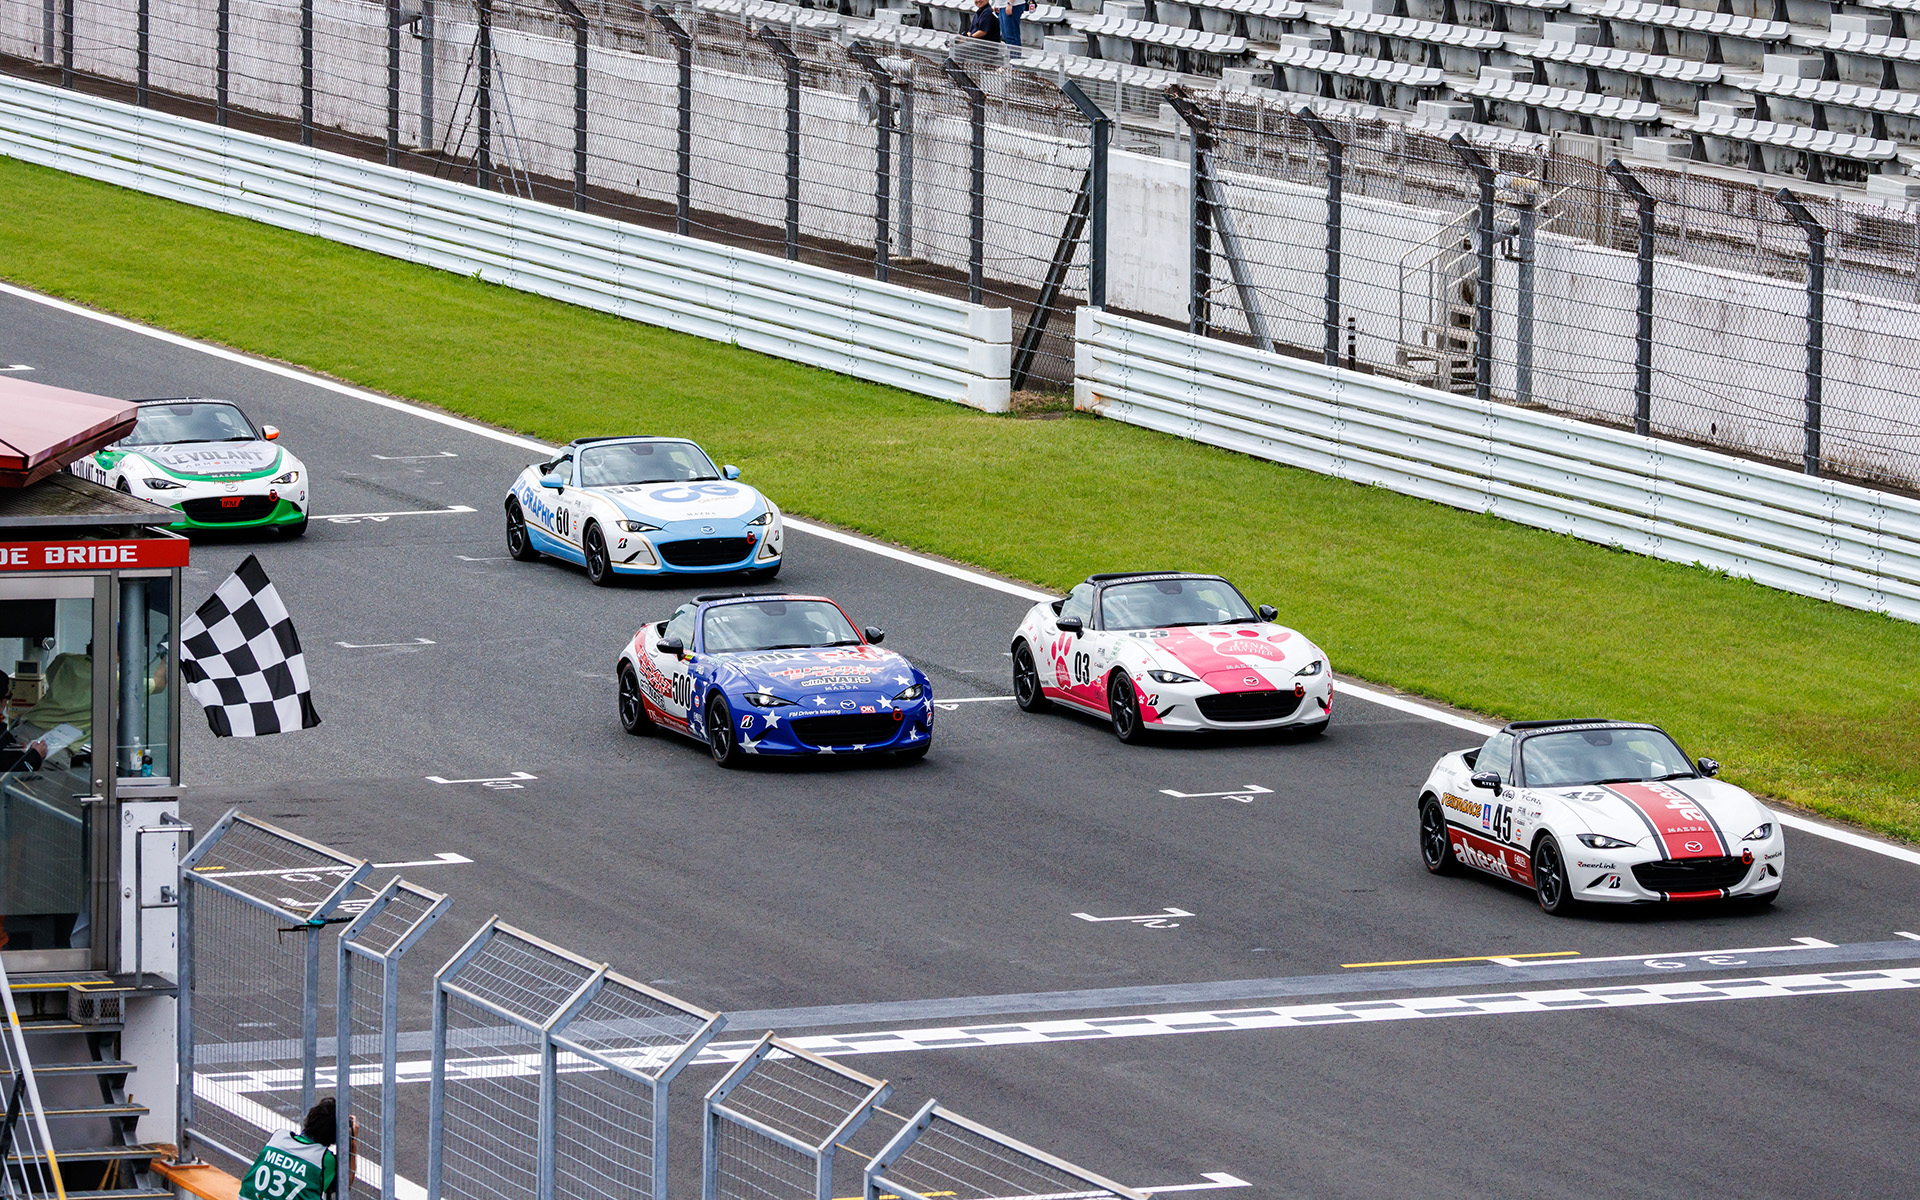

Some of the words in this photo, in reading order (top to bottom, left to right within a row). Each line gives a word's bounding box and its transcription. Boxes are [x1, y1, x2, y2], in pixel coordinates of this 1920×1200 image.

[162, 450, 263, 465] LEVOLANT
[521, 486, 555, 532] GRAPHIC
[555, 505, 570, 537] 60
[43, 545, 138, 564] BRIDE
[1112, 576, 1147, 584] MAZDA
[1229, 645, 1274, 657] PANTHER
[1233, 640, 1272, 651] PINK
[1074, 651, 1090, 686] 03
[672, 671, 693, 711] 500
[802, 679, 823, 687] with
[822, 676, 870, 684] NATS
[1535, 725, 1575, 734] MAZDA
[1576, 722, 1606, 730] SPIRIT
[1609, 721, 1648, 729] RACING
[1560, 791, 1607, 802] 45
[1492, 803, 1514, 842] 45
[1452, 837, 1513, 879] ahead
[1577, 861, 1617, 870] RacerLink
[263, 1149, 308, 1177] MEDIA
[254, 1164, 308, 1200] 037
